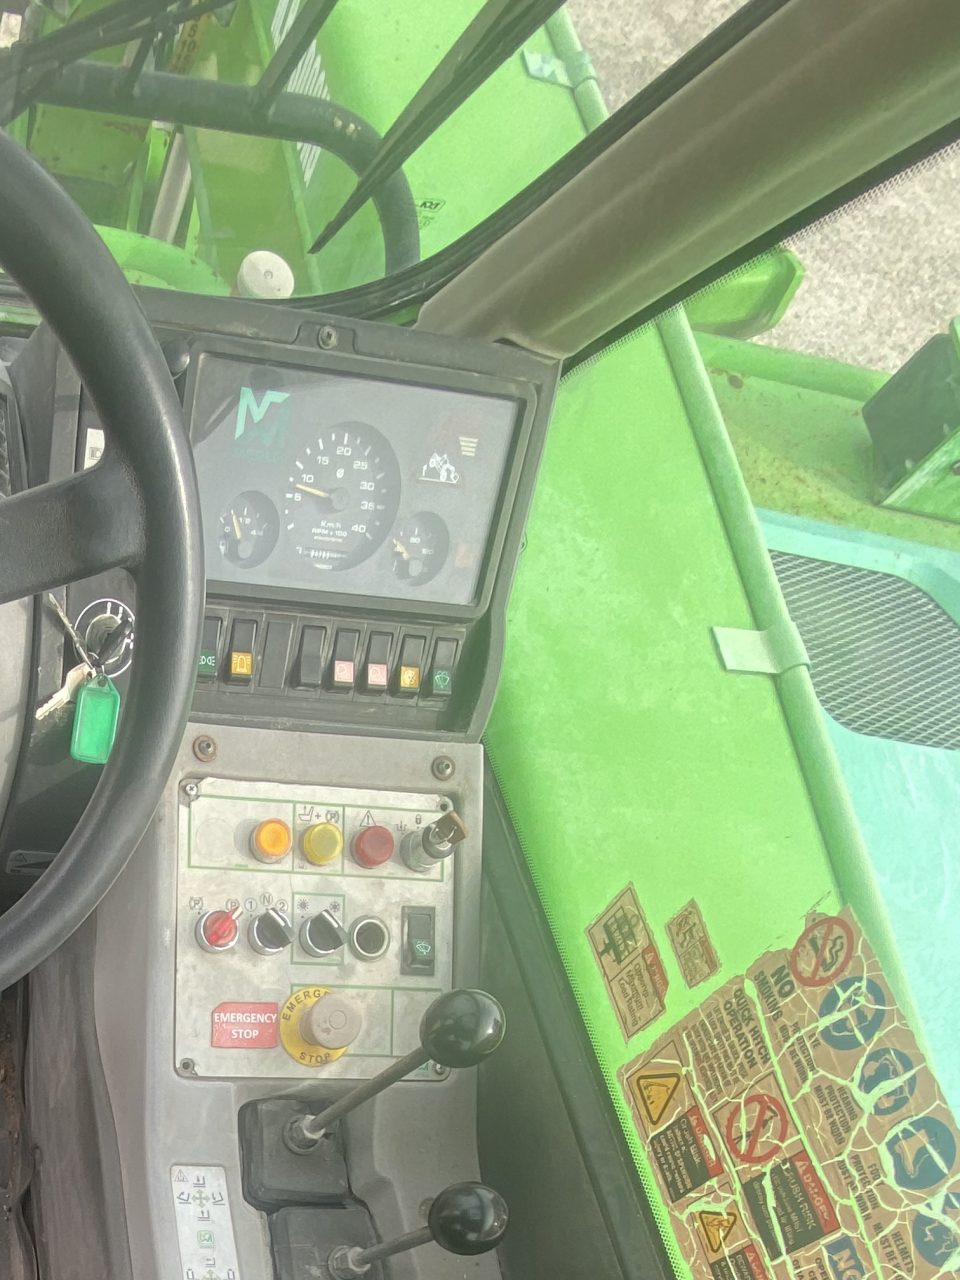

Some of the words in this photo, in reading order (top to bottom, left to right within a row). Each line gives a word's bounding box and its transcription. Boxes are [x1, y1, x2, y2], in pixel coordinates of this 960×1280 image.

[336, 446, 351, 456] 20
[317, 456, 329, 465] 15
[353, 460, 368, 470] 25
[301, 474, 314, 483] 10
[359, 481, 375, 491] 30
[351, 523, 366, 533] 40
[617, 977, 630, 999] Load
[769, 963, 796, 1001] NO
[754, 969, 782, 1022] SMOKING
[214, 1013, 277, 1023] EMERGENCY
[731, 987, 754, 1026] QUICK
[748, 1025, 771, 1066] HITCH
[231, 1029, 259, 1039] STOP
[722, 998, 757, 1069] OPERATION
[299, 1051, 331, 1065] STOP
[824, 1084, 851, 1135] PROTECTION
[836, 1085, 857, 1122] HEARING
[813, 1084, 829, 1109] MUST
[828, 1118, 844, 1146] WORN
[798, 1202, 816, 1229] RISK
[885, 1249, 896, 1263] BE
[891, 1230, 915, 1274] HELMETS
